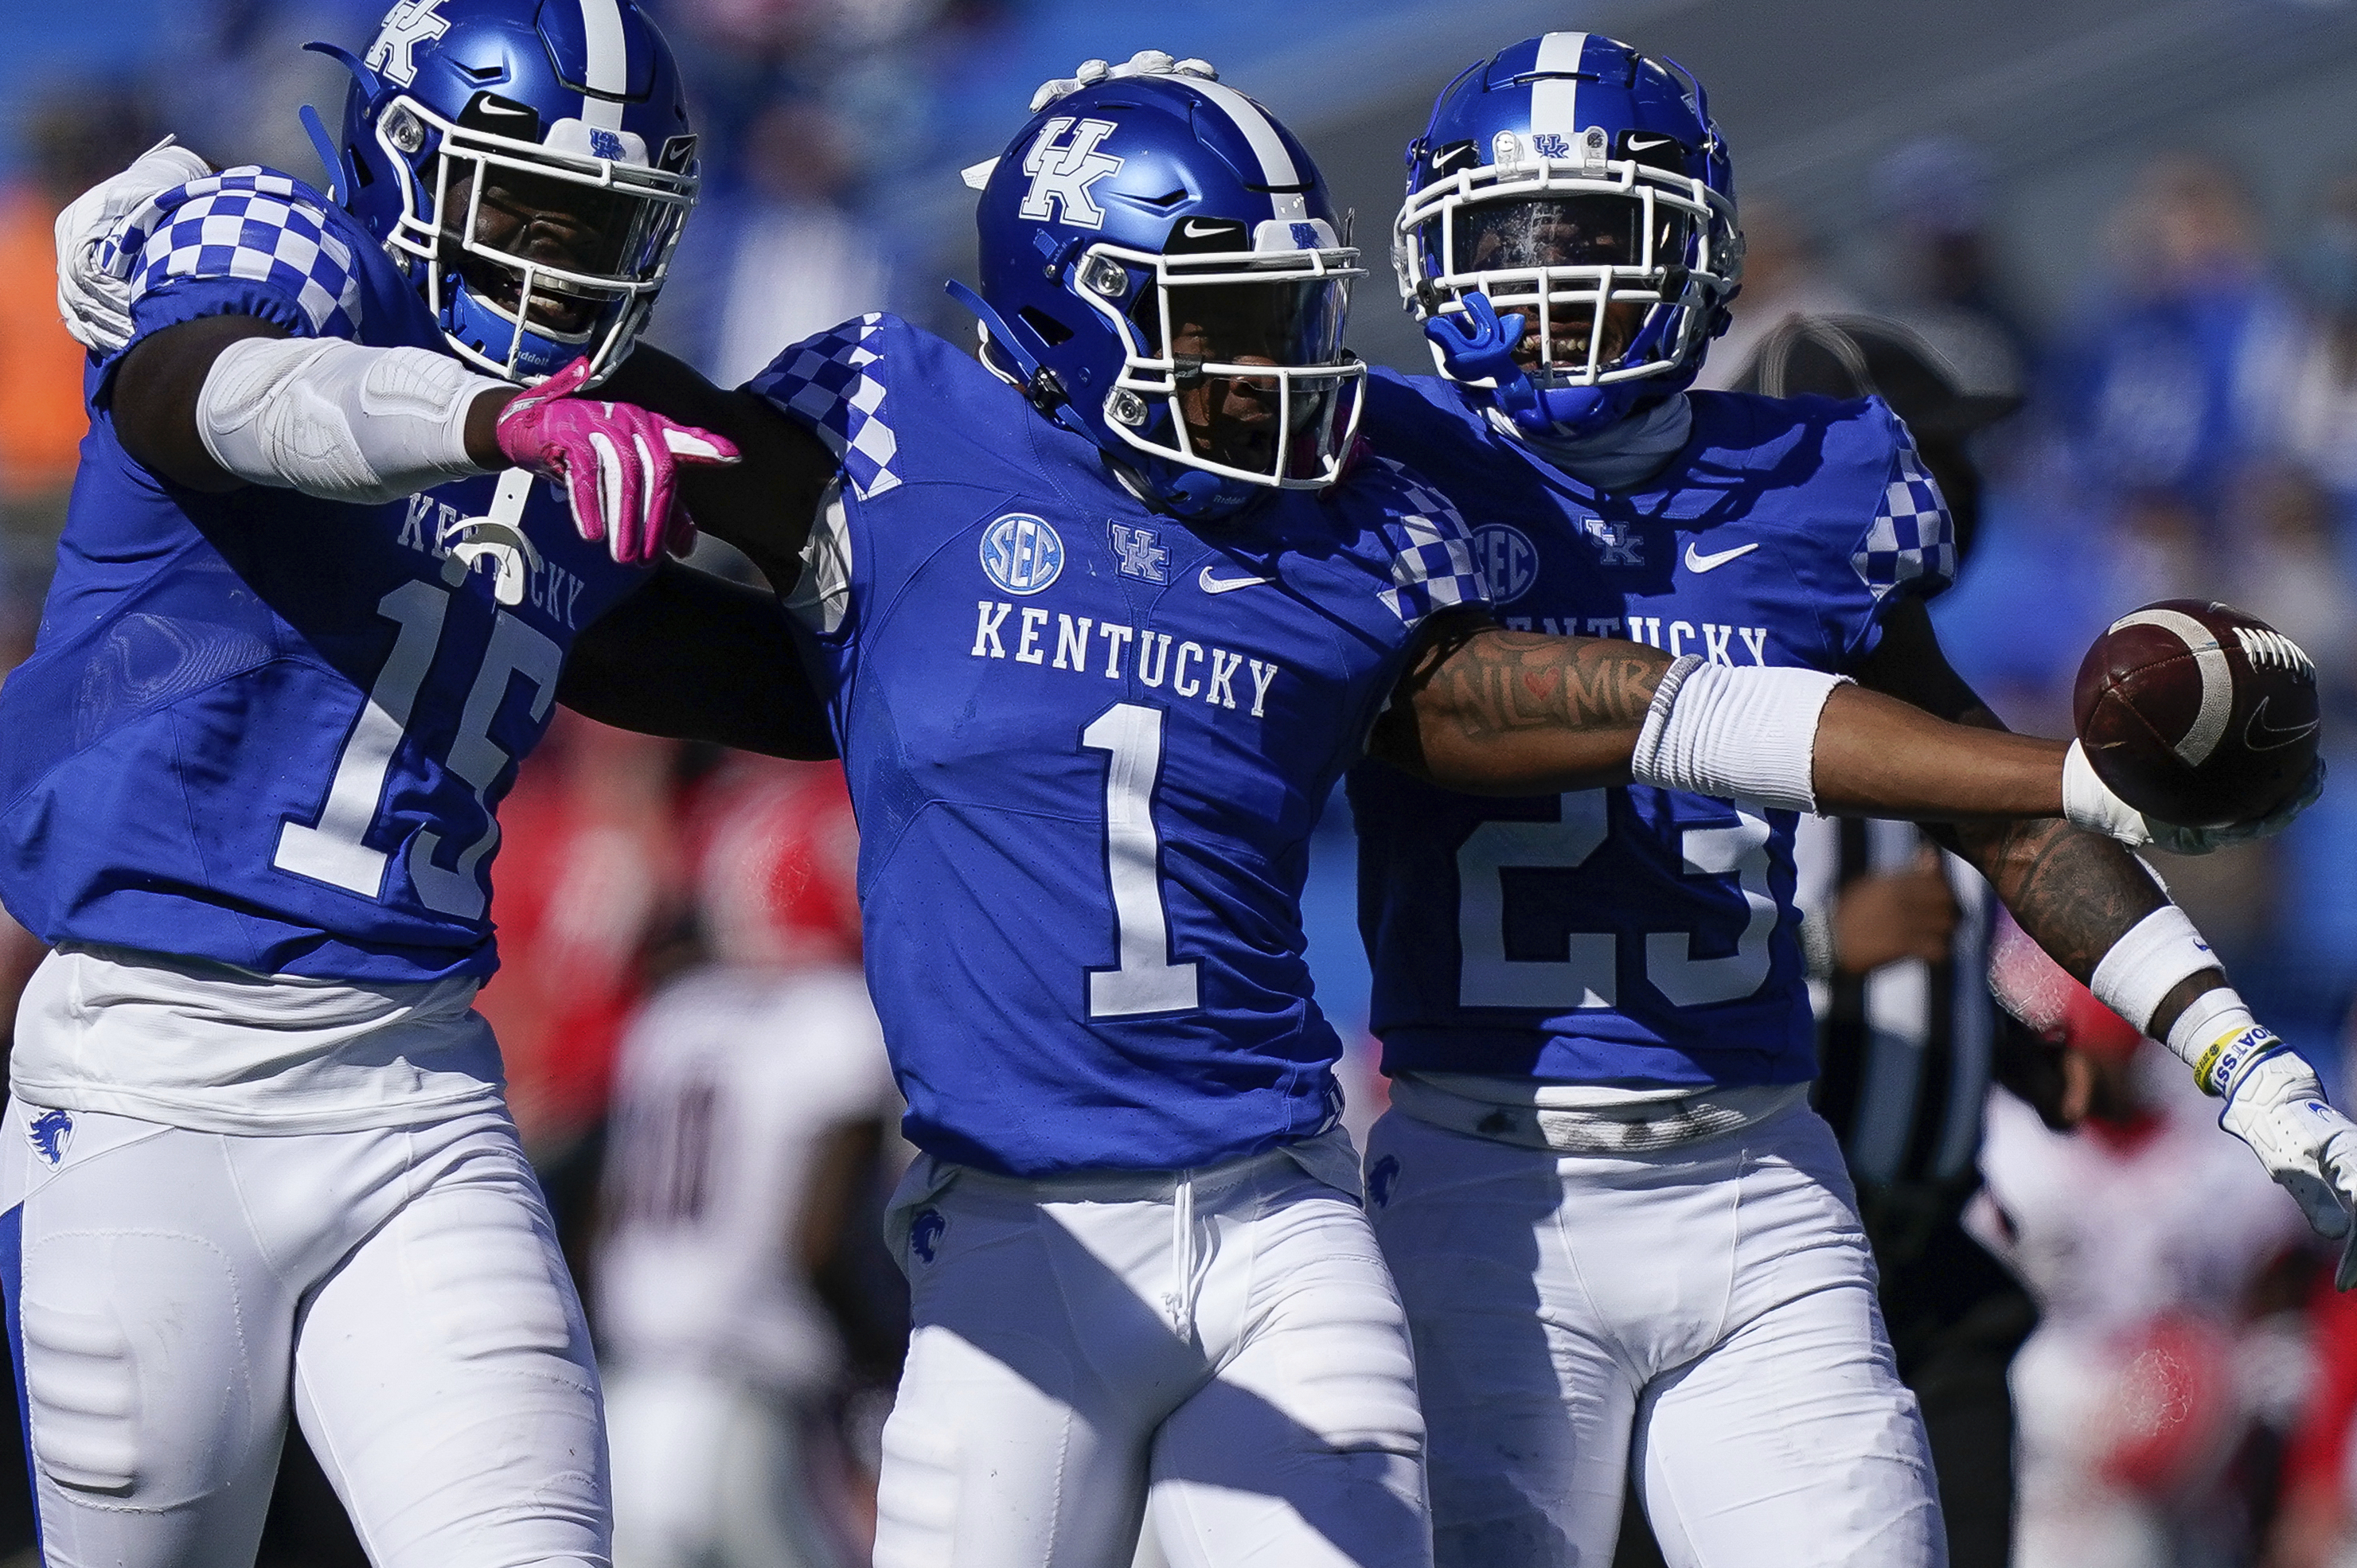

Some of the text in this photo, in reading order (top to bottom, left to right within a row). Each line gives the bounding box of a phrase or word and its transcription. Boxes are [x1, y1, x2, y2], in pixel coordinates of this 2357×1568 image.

[1018, 116, 1126, 230] UK
[989, 519, 1056, 588] SEC
[1110, 521, 1168, 584] UK
[1586, 519, 1645, 566] UK
[971, 600, 1278, 717] KENTUCKY
[274, 579, 563, 920] 15
[1083, 702, 1199, 1017] 1
[1457, 788, 1778, 1008] 23
